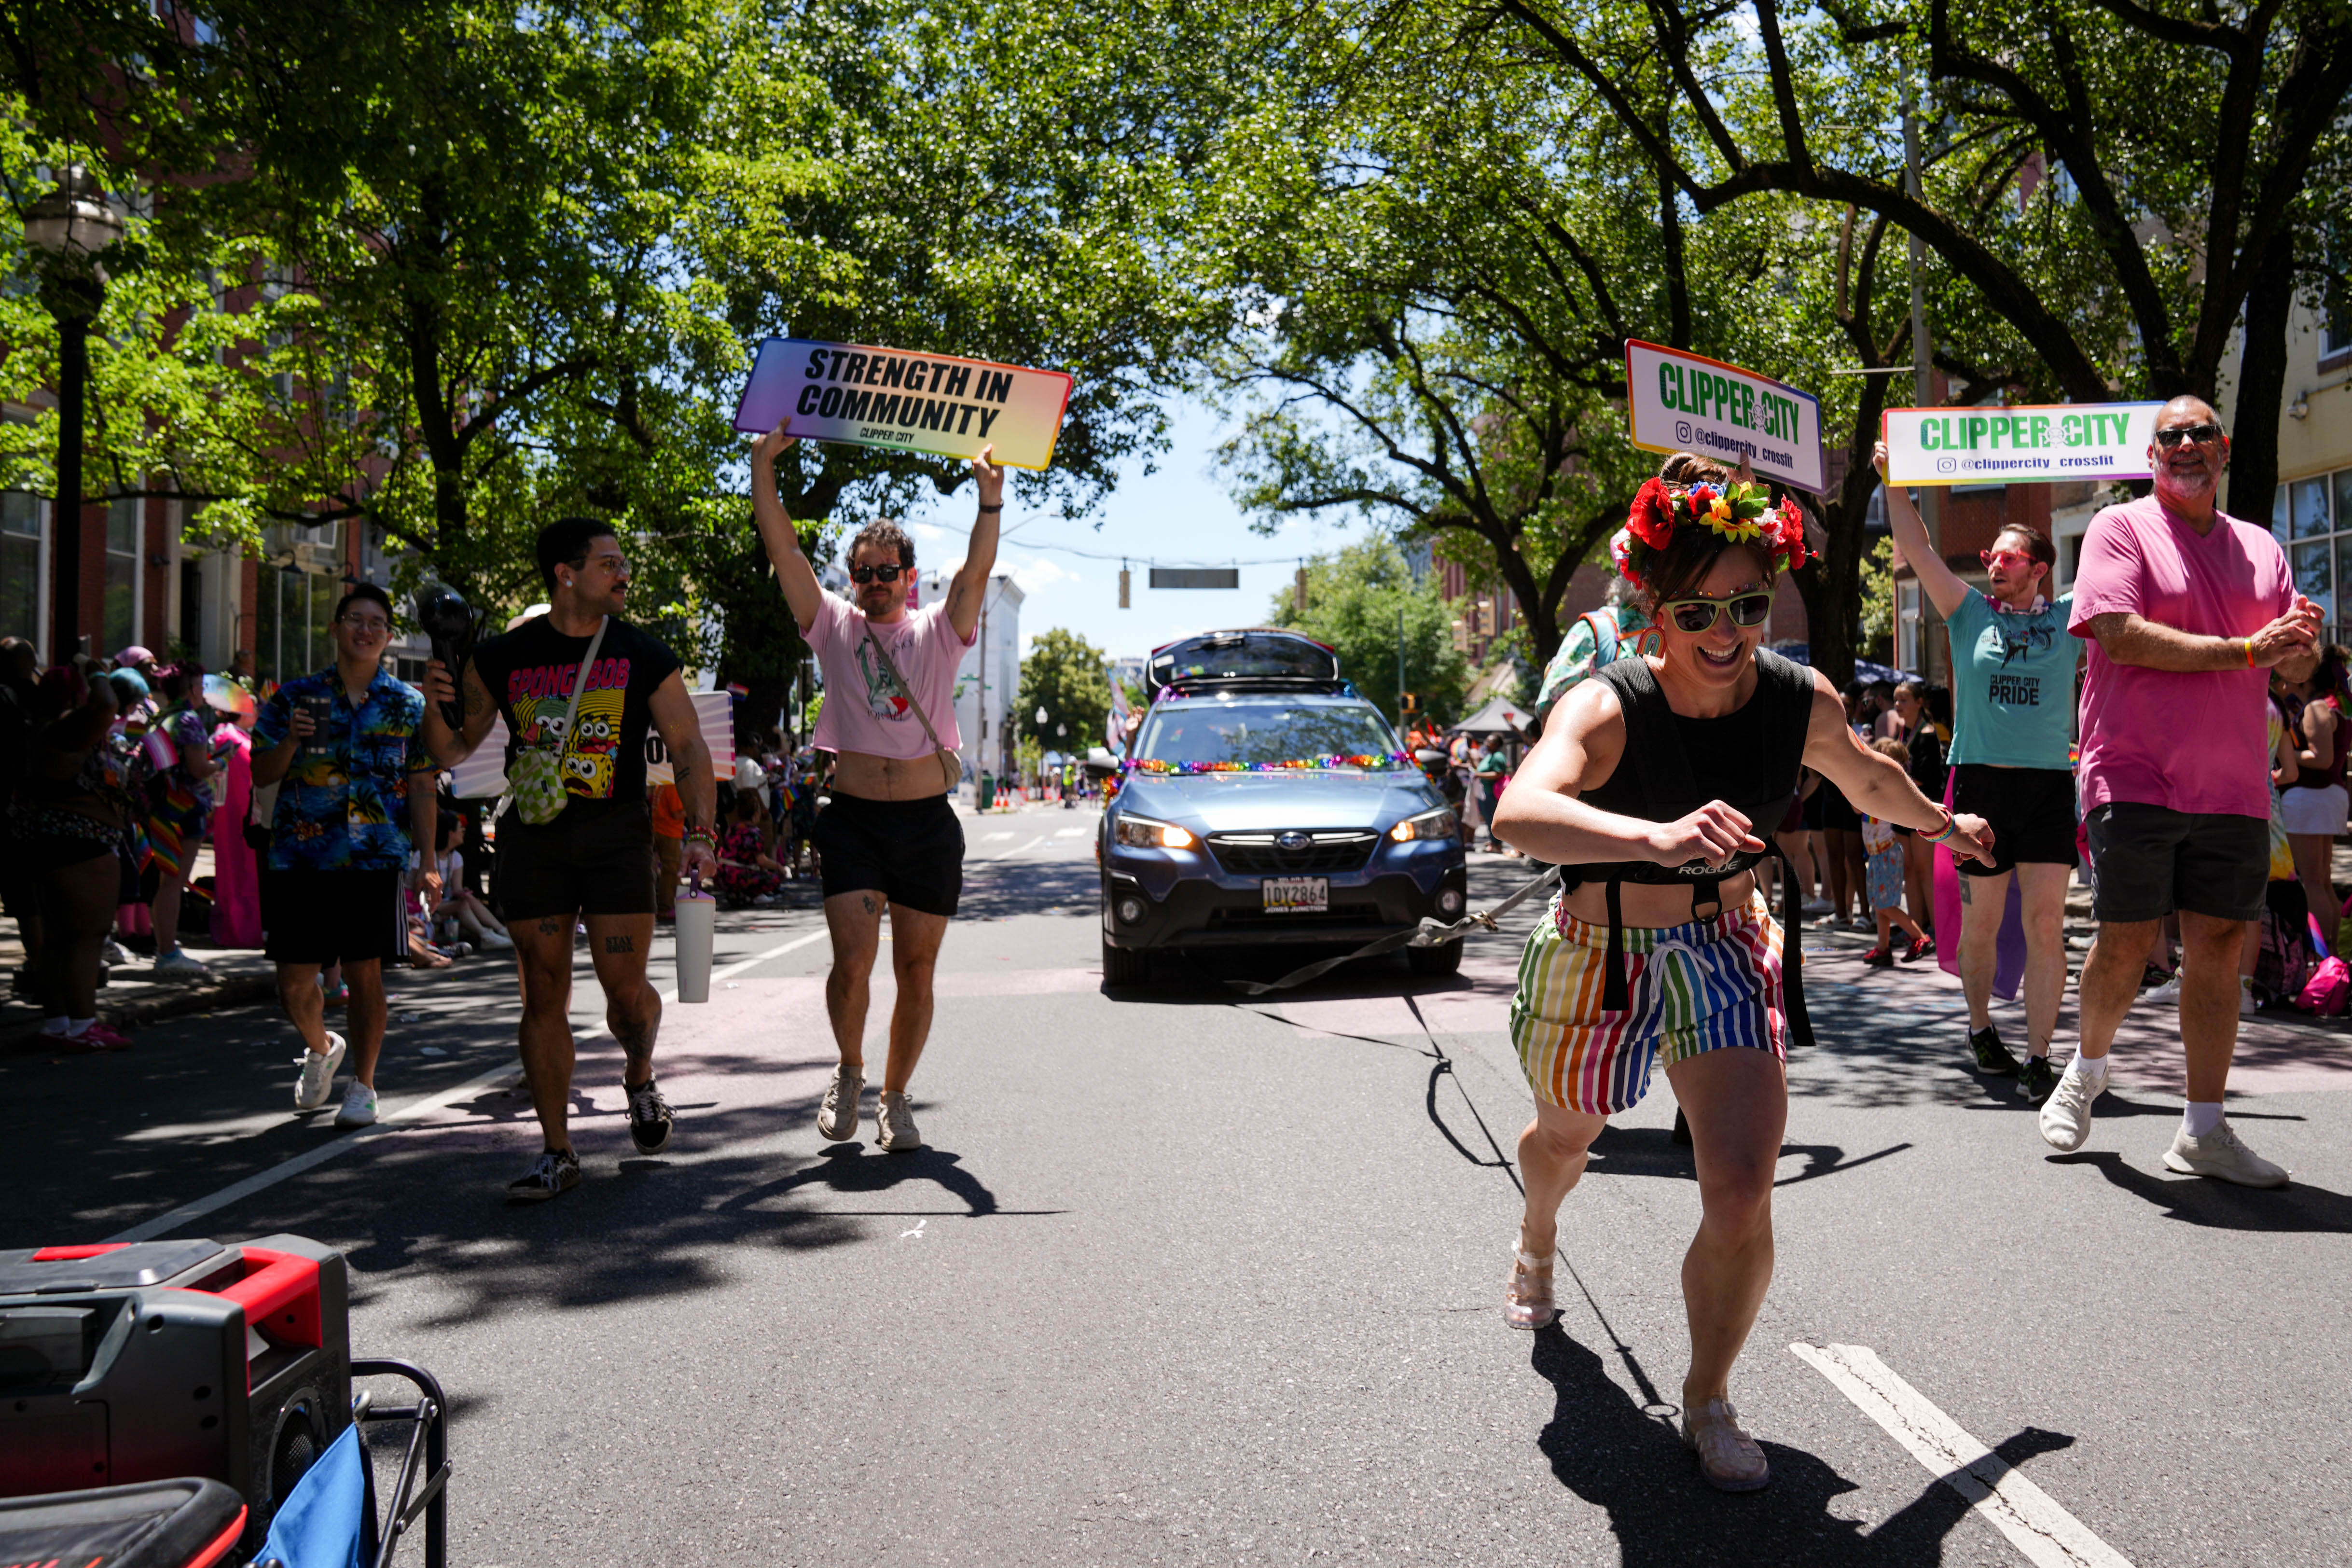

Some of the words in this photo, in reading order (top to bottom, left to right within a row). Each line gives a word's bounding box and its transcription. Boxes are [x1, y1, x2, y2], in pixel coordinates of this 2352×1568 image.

[805, 348, 972, 397] STRENGTH
[974, 370, 1013, 403] IN
[796, 384, 1000, 438] COMMUNITY
[1659, 361, 1756, 430] CLIPPER
[1761, 390, 1799, 445] CITY
[859, 426, 894, 442] CLIPPER
[895, 429, 914, 444] CITY
[1920, 416, 2051, 451] CLIPPER
[2061, 413, 2130, 447] CITY
[1695, 427, 1793, 469] @clippercity_crossfit
[1961, 455, 2114, 471] @clippercity_crossfit
[1990, 674, 2021, 685] CLIPPER
[2023, 677, 2040, 687] CITY
[1989, 685, 2039, 706] PRIDE
[1678, 860, 1738, 875] ROGUE
[1265, 885, 1326, 905] 1DY2864
